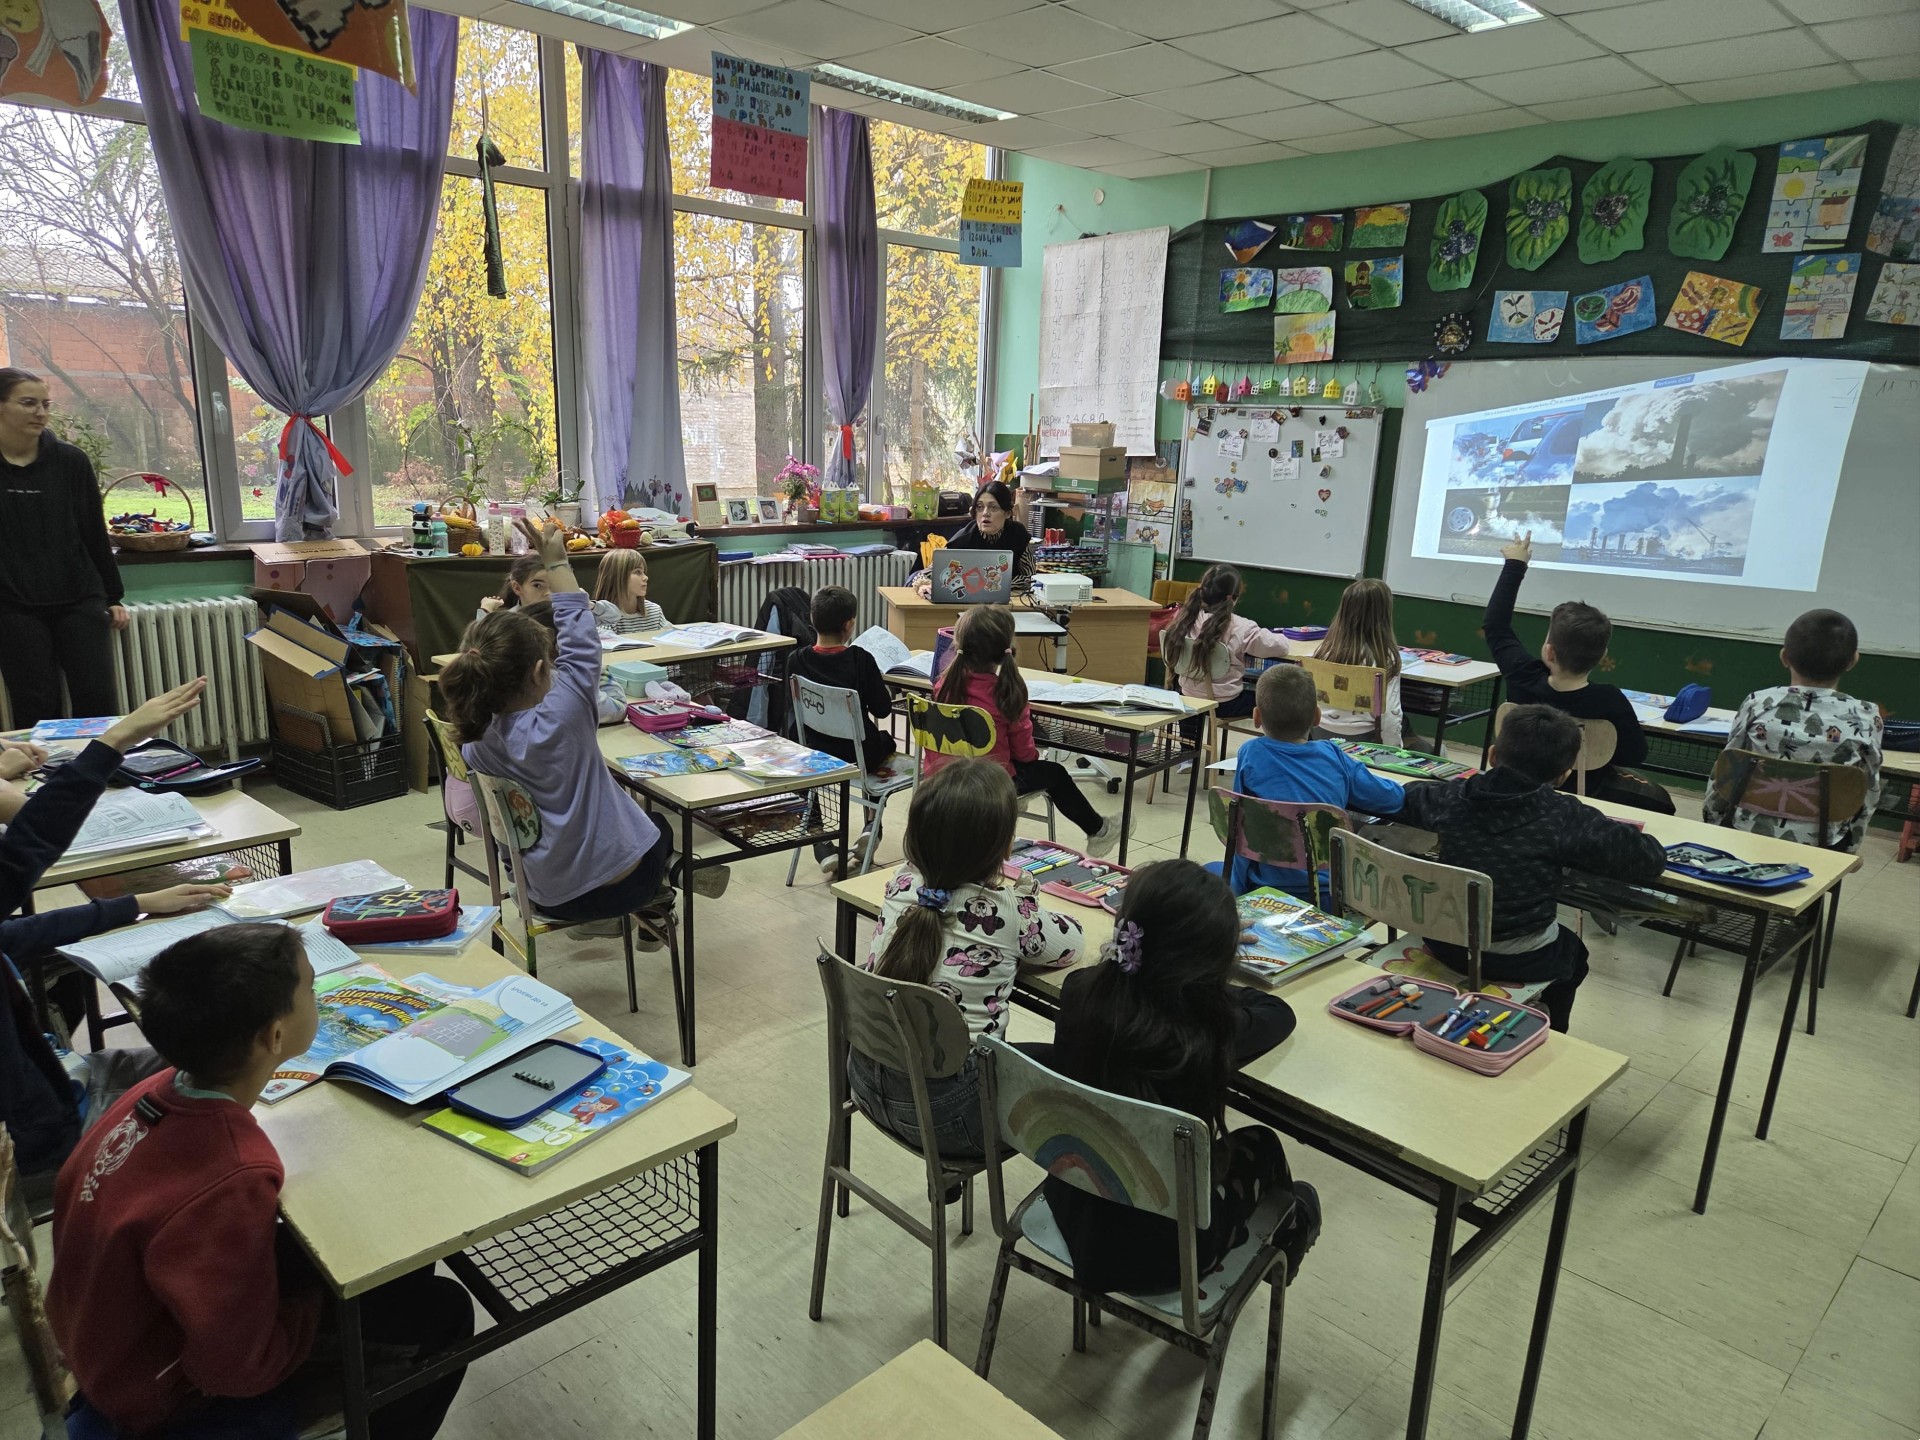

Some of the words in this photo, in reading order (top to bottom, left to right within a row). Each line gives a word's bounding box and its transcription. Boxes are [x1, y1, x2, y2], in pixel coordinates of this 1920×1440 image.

[1055, 278, 1063, 292] 22
[1122, 268, 1134, 285] 28
[1052, 329, 1062, 342] 52
[1121, 322, 1131, 337] 58
[1051, 345, 1062, 359] 62
[1120, 340, 1130, 354] 68
[1120, 357, 1130, 369] 78
[335, 988, 402, 1002] Шарена
